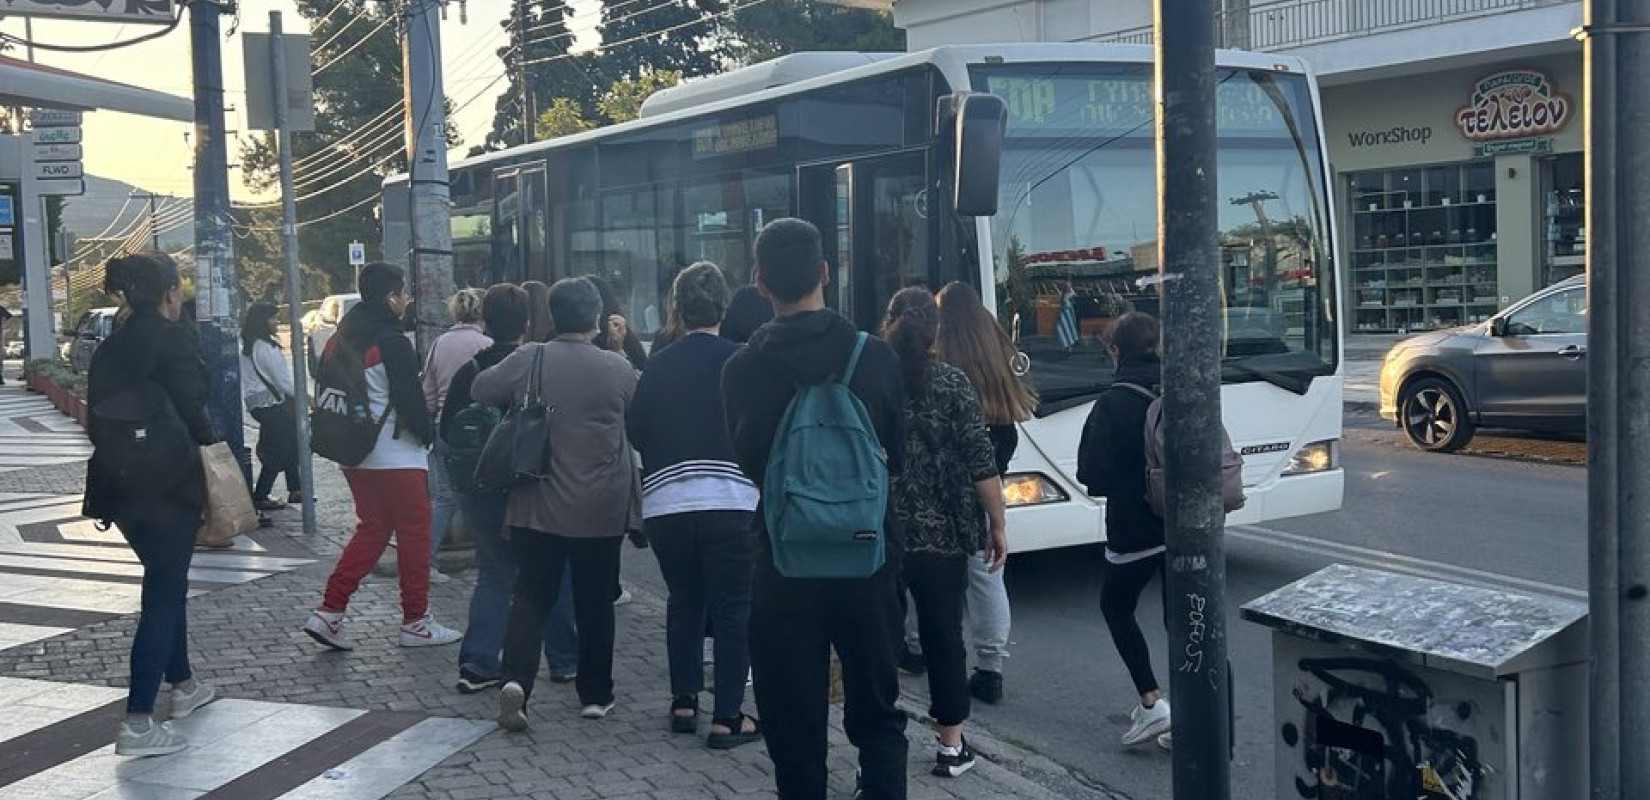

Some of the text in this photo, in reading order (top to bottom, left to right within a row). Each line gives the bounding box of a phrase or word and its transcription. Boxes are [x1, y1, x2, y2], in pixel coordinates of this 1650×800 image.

[1460, 94, 1565, 133] τέλειον
[1347, 126, 1432, 148] WorkShop
[316, 383, 348, 416] VAN
